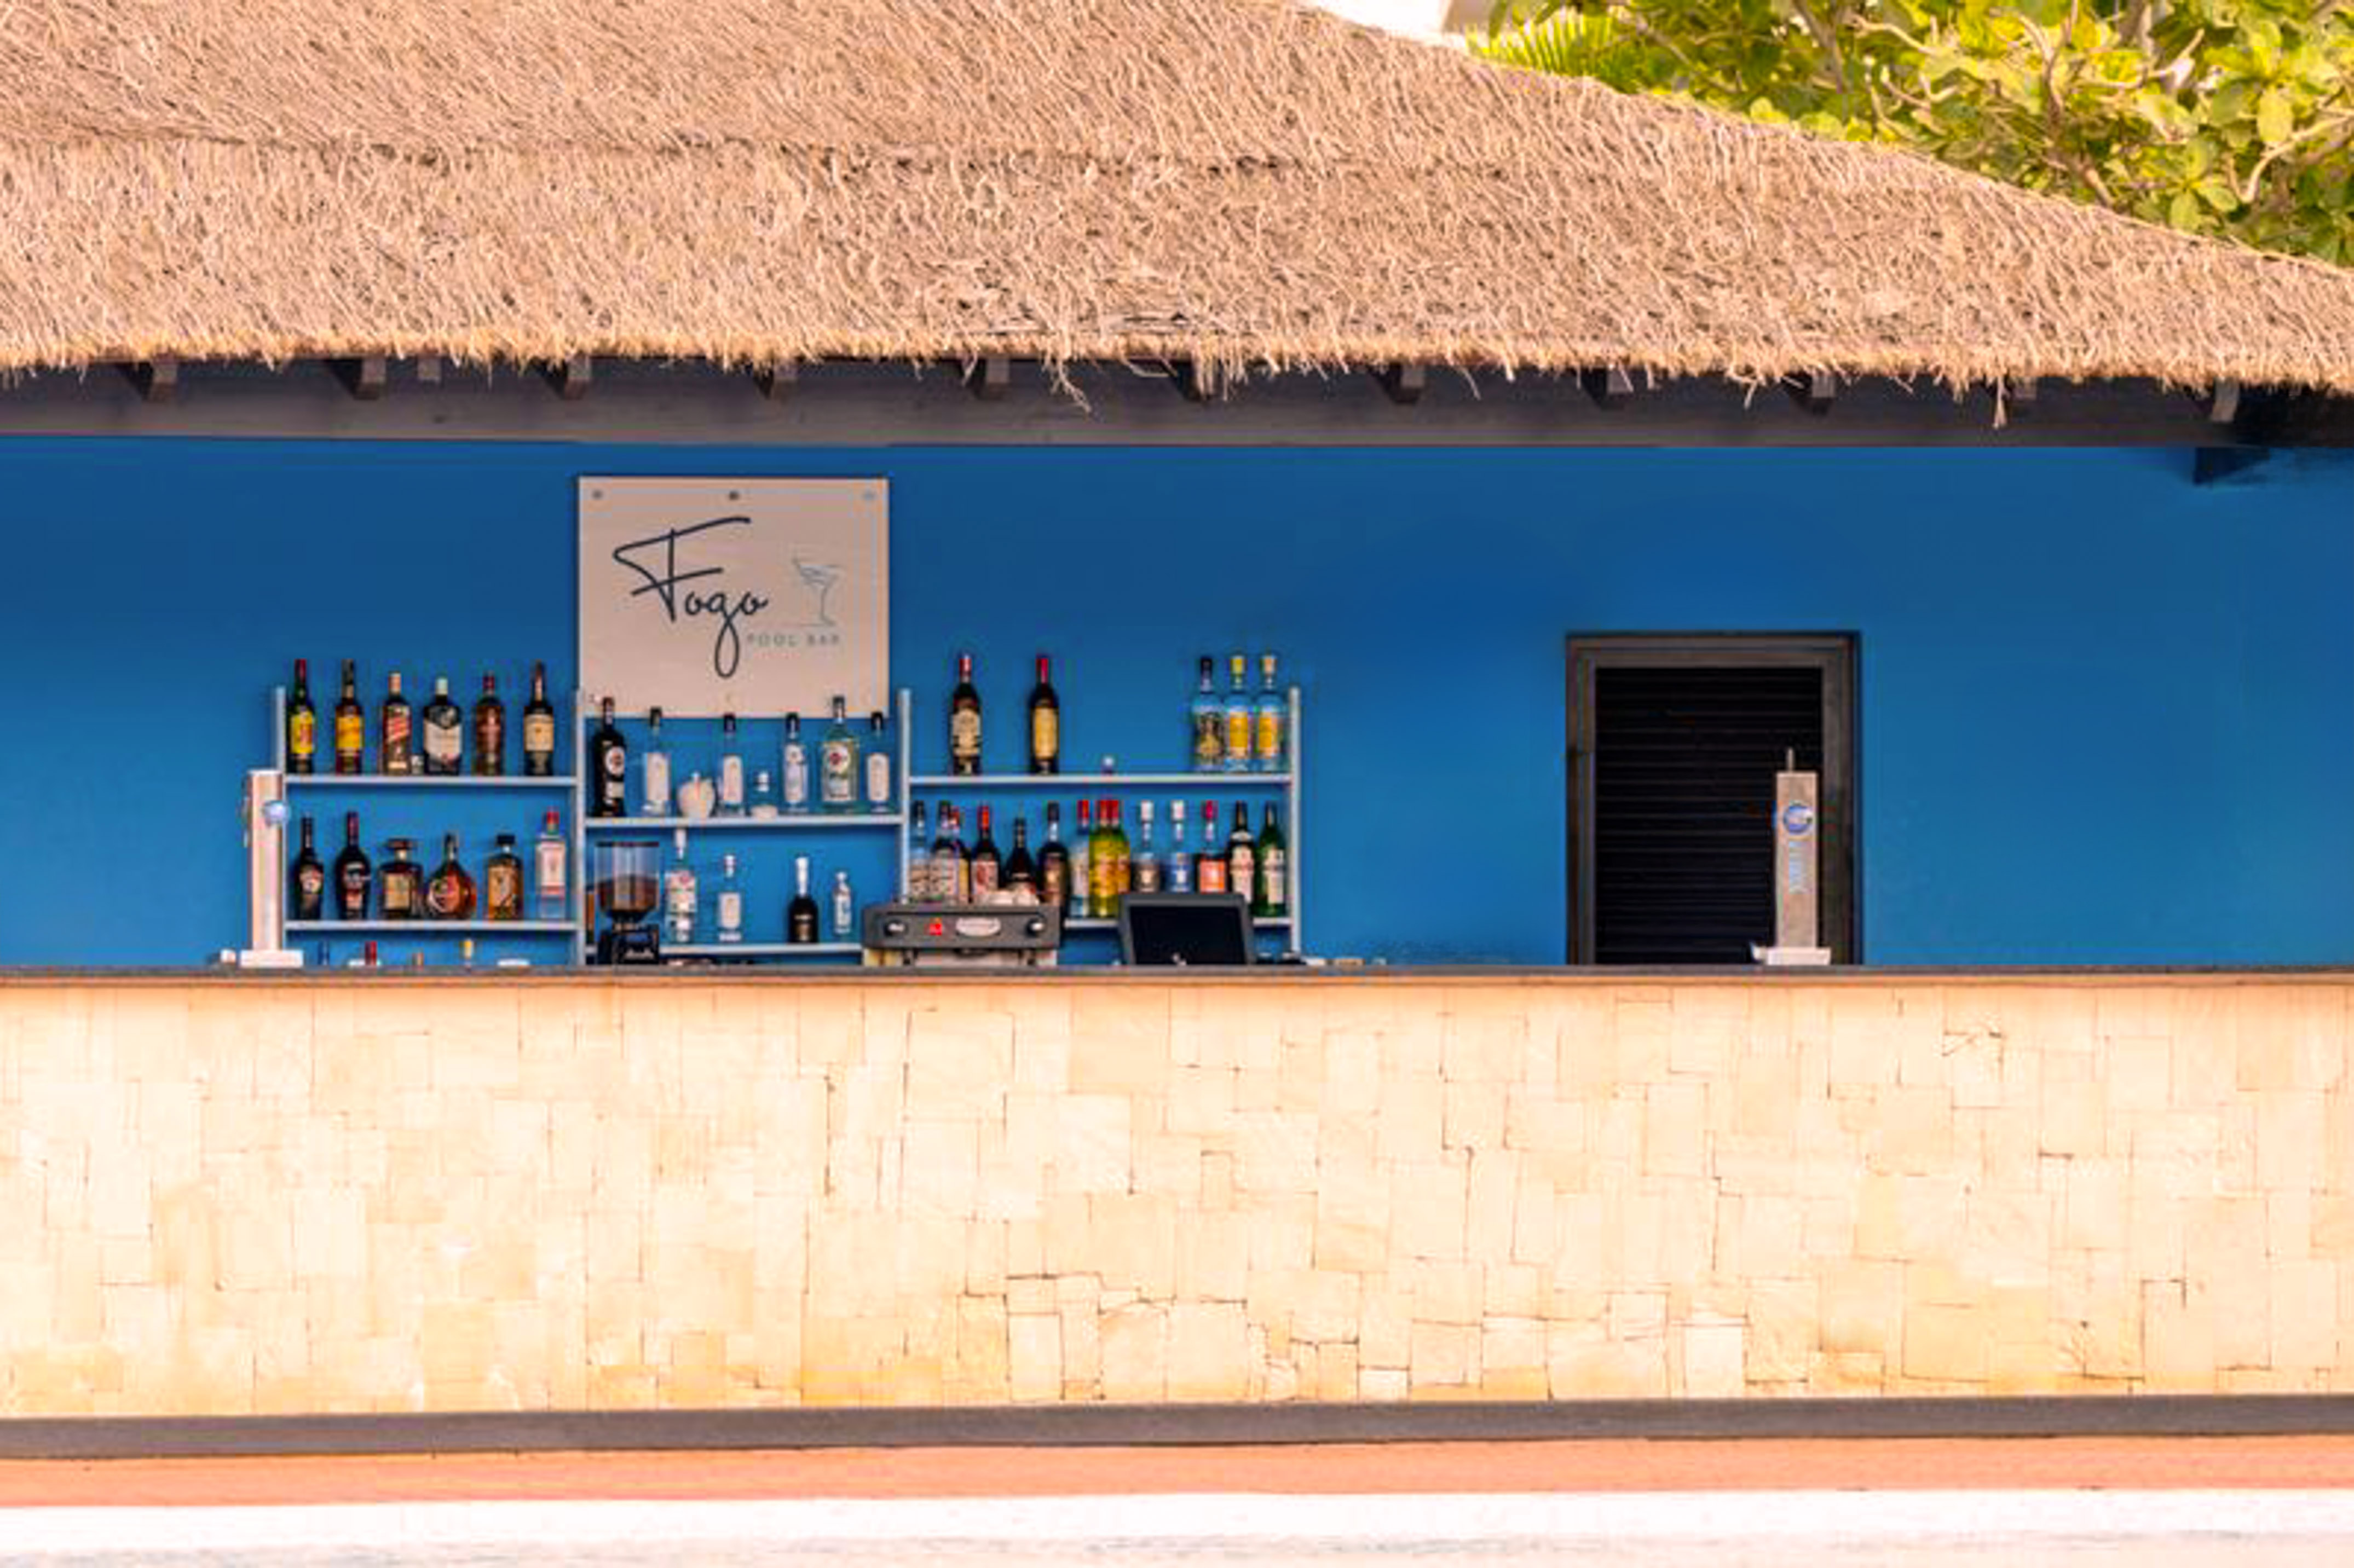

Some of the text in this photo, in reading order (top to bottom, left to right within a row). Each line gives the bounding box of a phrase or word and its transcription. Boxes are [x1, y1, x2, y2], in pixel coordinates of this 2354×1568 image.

[613, 516, 769, 678] Fogo
[747, 633, 840, 647] POOL BAR
